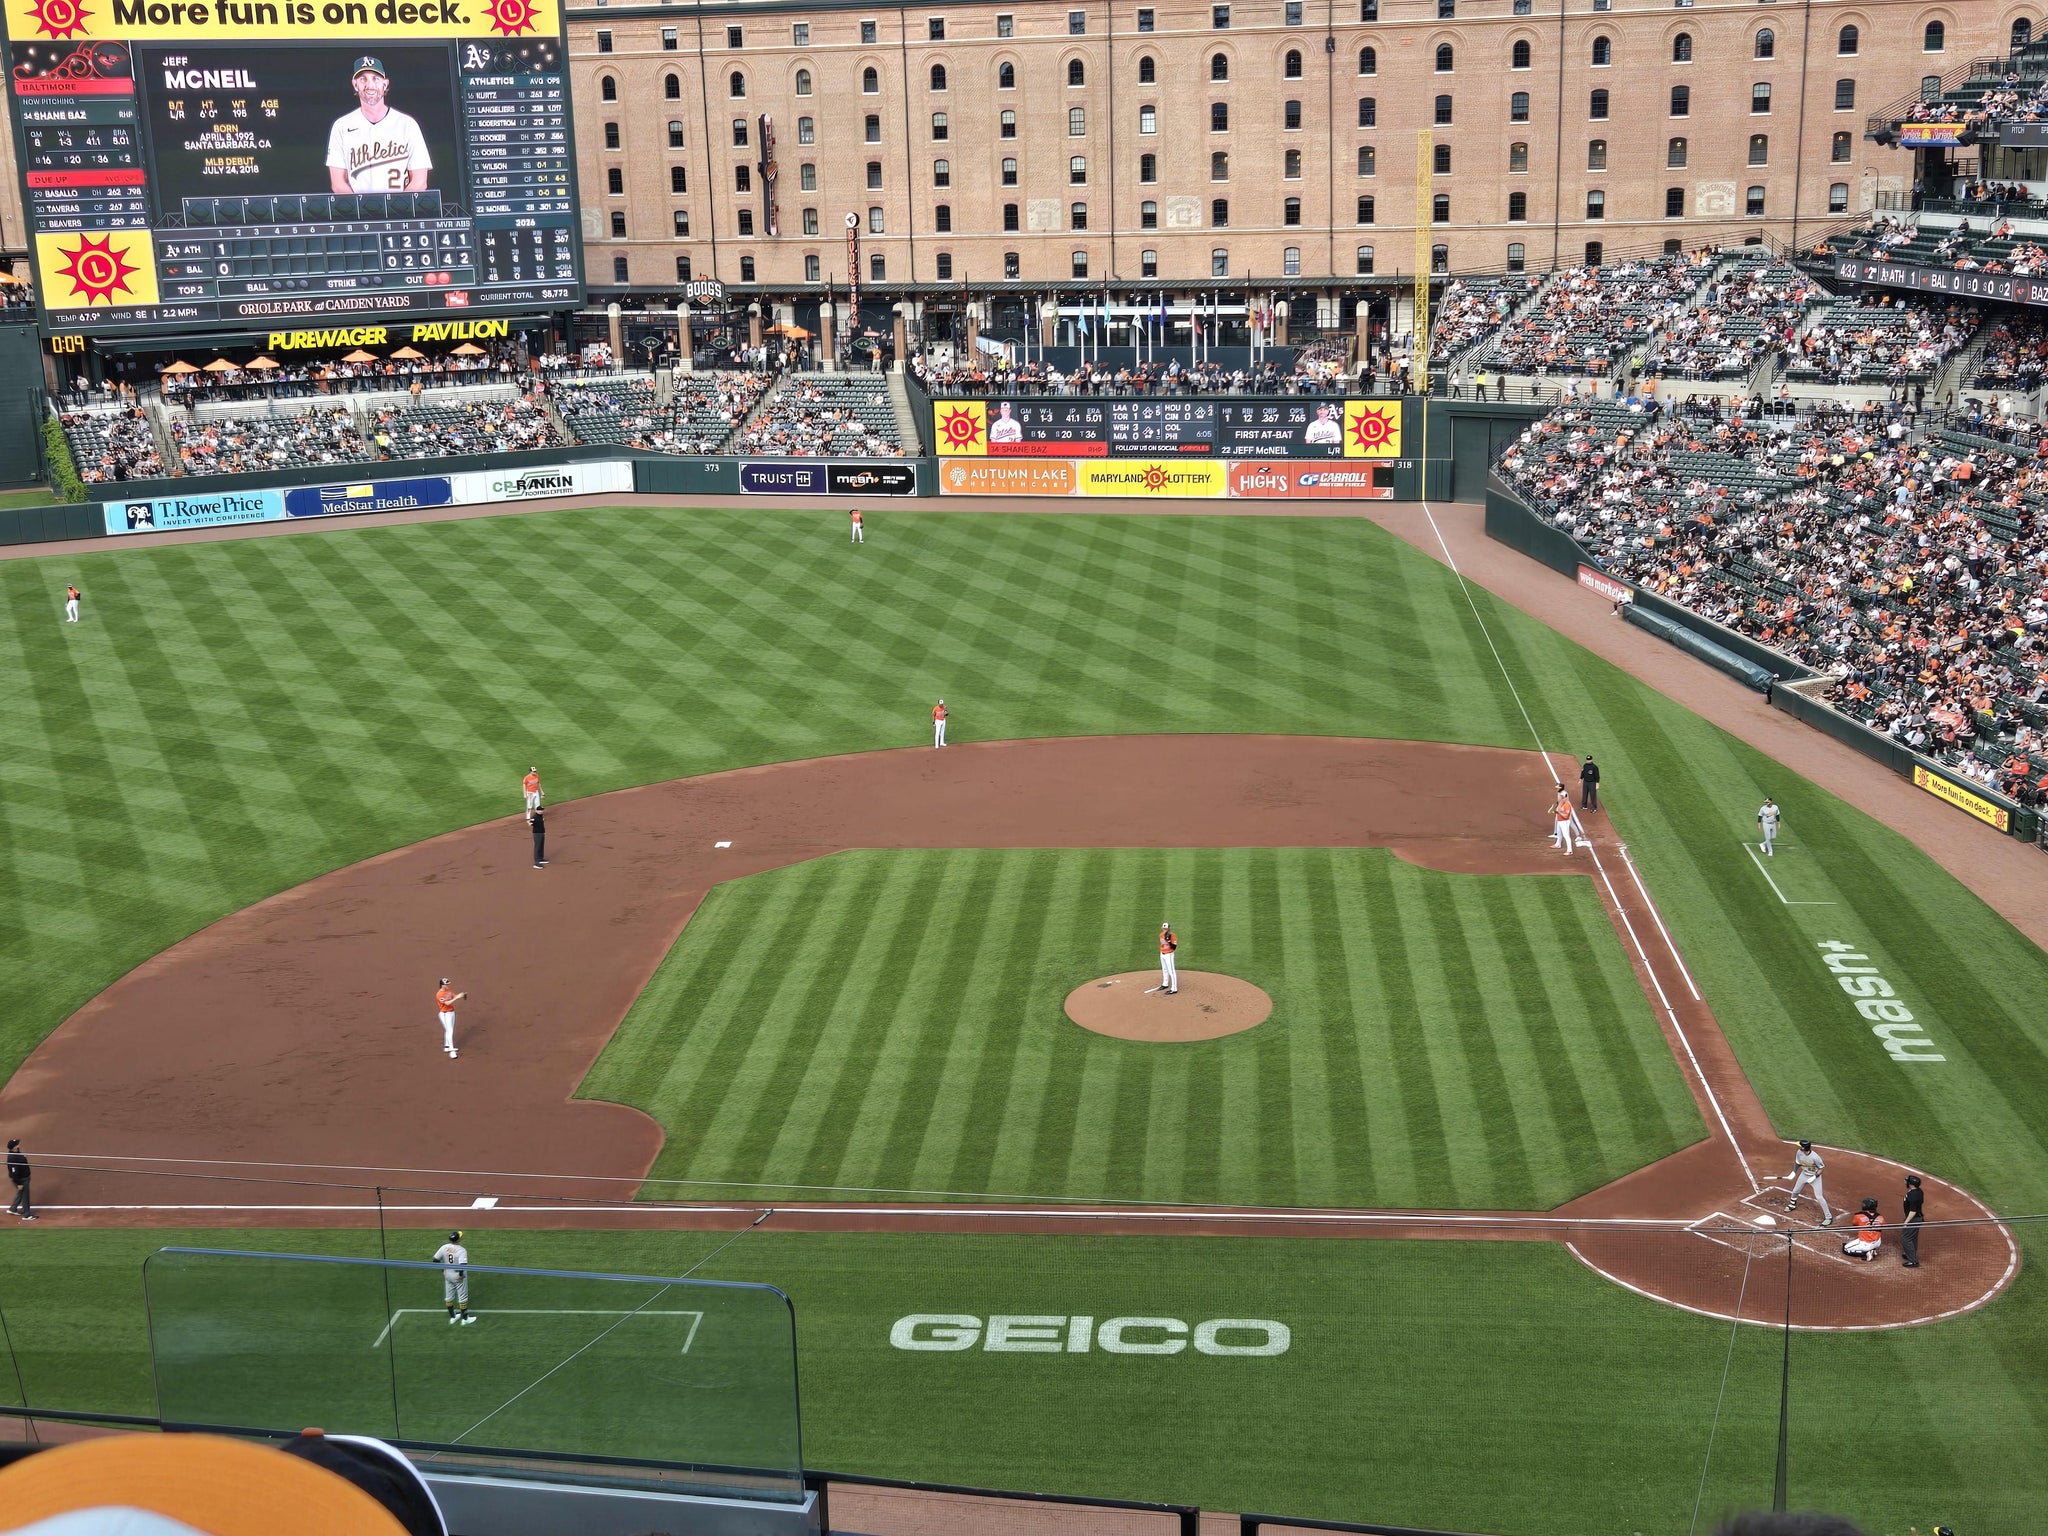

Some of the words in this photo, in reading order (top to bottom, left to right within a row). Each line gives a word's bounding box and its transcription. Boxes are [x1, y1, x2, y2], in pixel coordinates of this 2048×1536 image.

[114, 0, 209, 25] More
[215, 0, 279, 25] fun
[287, 0, 315, 25] is
[322, 2, 363, 25] on
[375, 0, 471, 25] deck.
[162, 56, 188, 66] JEFF
[164, 70, 256, 88] MCNEIL
[470, 77, 514, 86] ATHLETICS
[168, 100, 184, 110] B/T
[202, 100, 213, 109] HT
[232, 100, 246, 108] WT
[261, 100, 279, 108] AGE
[34, 112, 66, 120] SHANE
[68, 110, 87, 120] BAZ
[170, 110, 185, 120] L/R
[265, 109, 276, 117] 34
[214, 124, 238, 132] BORN
[200, 132, 222, 141] APRIL
[236, 132, 254, 140] 1992
[86, 138, 100, 146] 41.1
[184, 142, 213, 150] SANTA
[215, 140, 257, 150] BARBARA,
[258, 140, 272, 148] CA
[70, 156, 81, 164] 20
[98, 155, 108, 163] 36
[205, 158, 224, 166] MLB
[226, 157, 254, 166] DEBUT
[203, 166, 224, 174] JULY
[226, 166, 238, 174] 24,
[240, 165, 259, 174] 2018
[45, 190, 78, 198] BASALLO
[49, 220, 82, 228] BEAVERS
[184, 246, 200, 254] ATH
[402, 236, 411, 248] 2
[420, 236, 428, 246] 0
[441, 234, 450, 246] 4
[186, 266, 202, 274] BAL
[220, 264, 228, 275] 0
[388, 256, 396, 267] 0
[405, 255, 414, 266] 2
[422, 254, 430, 266] 0
[442, 254, 452, 265] 4
[460, 252, 468, 264] 2
[247, 284, 268, 292] BALL
[328, 279, 356, 288] STRIKE
[406, 276, 424, 284] OUT
[1840, 264, 1856, 278] 4:32
[1888, 269, 1904, 283] ATH
[1932, 274, 1946, 288] BAL
[1954, 276, 1960, 290] 0
[1972, 278, 1978, 292] 0
[1988, 280, 1994, 294] 0
[2004, 282, 2010, 296] 2
[2032, 286, 2048, 302] BAZ
[239, 302, 282, 315] ORIOLE
[284, 300, 312, 312] PARK
[326, 298, 374, 310] CAMDEN
[374, 296, 410, 308] YARDS
[111, 312, 132, 320] WIND
[136, 310, 146, 318] SE
[163, 309, 176, 318] 2.2
[178, 308, 198, 316] MPH
[268, 327, 387, 350] PUREWAGER
[412, 320, 508, 342] PAVILION
[52, 336, 84, 354] 0:09
[1288, 414, 1306, 422] .765
[1038, 430, 1046, 438] 16
[1062, 430, 1072, 438] 20
[1086, 430, 1096, 438] 36
[1236, 430, 1258, 438] FIRST
[1261, 430, 1293, 438] AT-BAT
[1233, 446, 1254, 454] JEFF
[1256, 446, 1288, 454] McNEIL
[1328, 446, 1340, 454] L/R
[704, 464, 720, 472] 373
[752, 473, 793, 484] TRUIST
[970, 468, 1028, 480] AUTUMN
[1034, 468, 1068, 480] LAKE
[1091, 474, 1144, 482] MARYLAND
[1168, 474, 1211, 483] LOTTERY
[1320, 472, 1366, 482] CARROLL
[516, 476, 572, 490] RANKIN
[1240, 473, 1288, 492] HIGH'S
[159, 502, 174, 518] T.
[176, 499, 222, 517] Rowe
[222, 496, 264, 512] Price
[323, 498, 373, 514] MedStar
[377, 496, 418, 509] Health
[217, 512, 264, 522] CONFIDENCE
[1594, 580, 1620, 600] market
[1932, 780, 1948, 794] More
[1948, 786, 1958, 800] fun
[1966, 798, 1974, 808] on
[1974, 802, 1992, 818] deck.
[448, 1254, 454, 1264] 8
[890, 1314, 1290, 1356] GEICO
